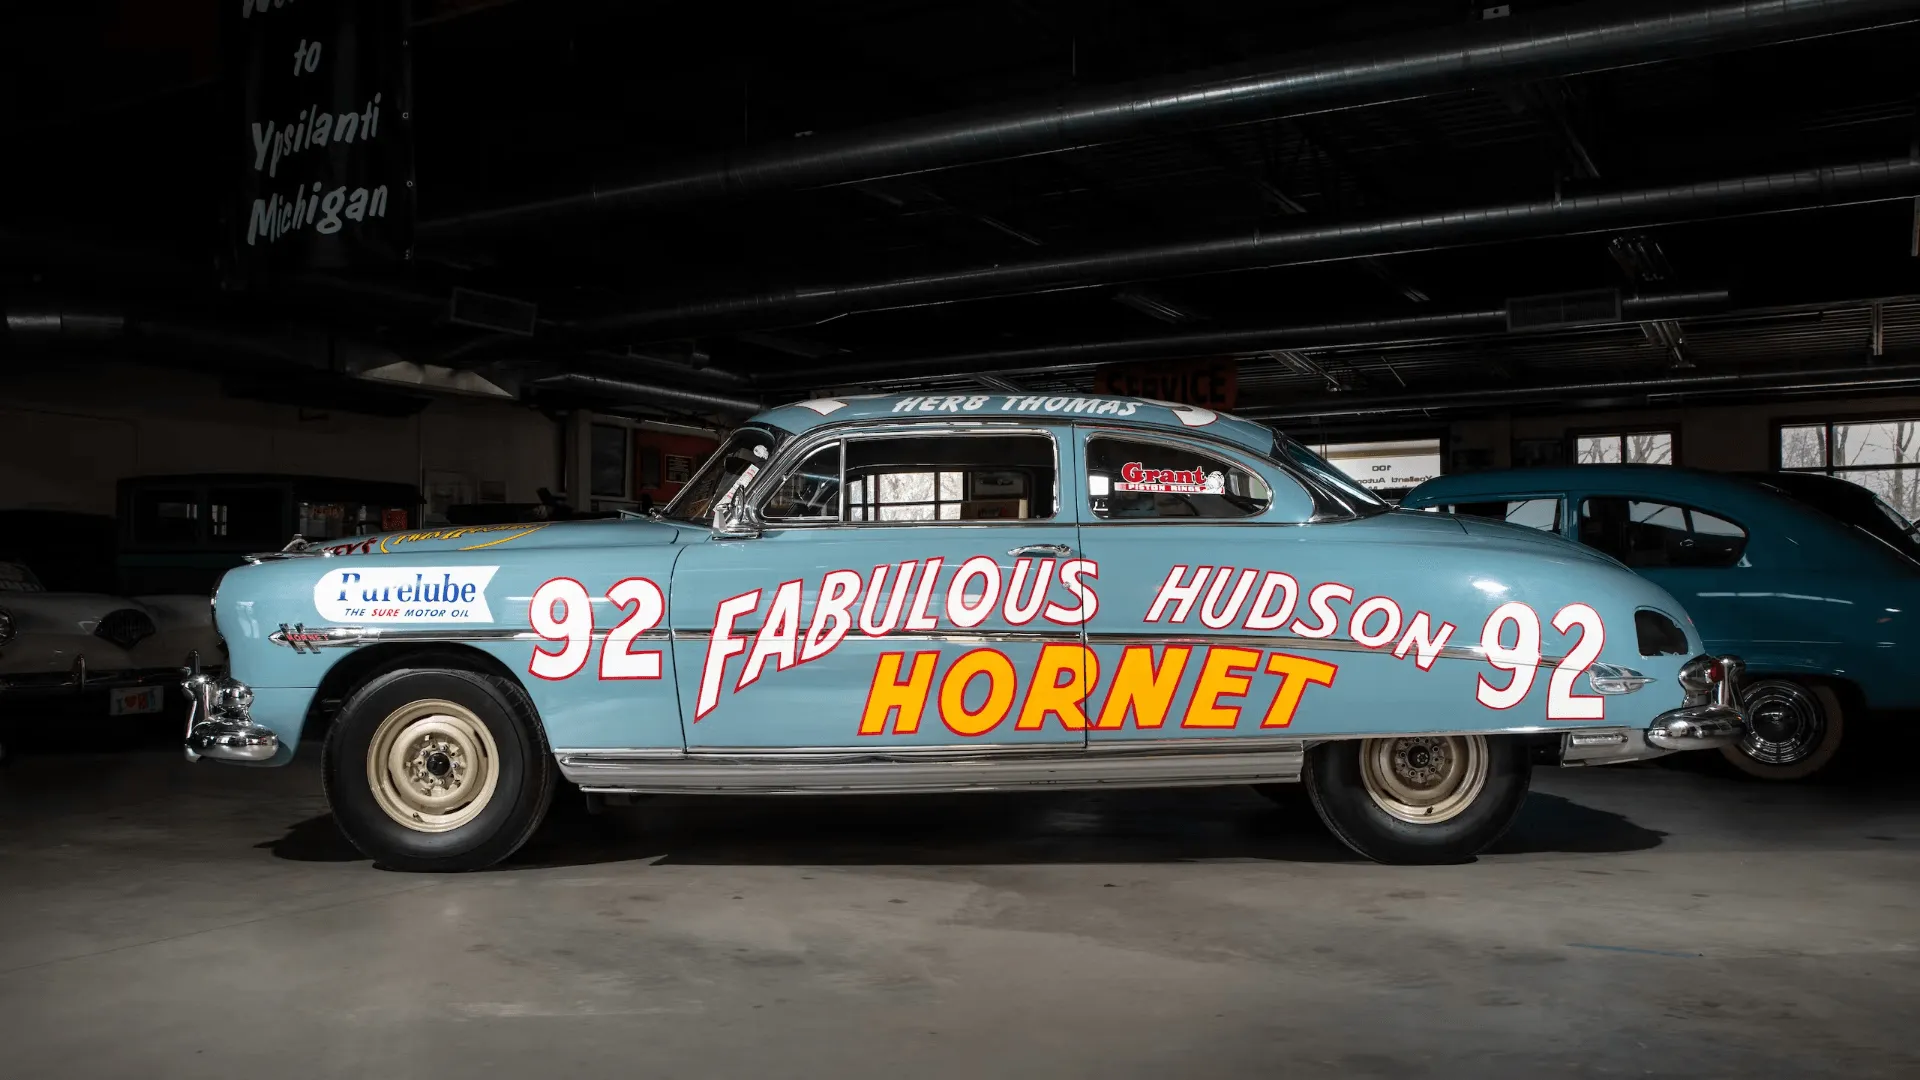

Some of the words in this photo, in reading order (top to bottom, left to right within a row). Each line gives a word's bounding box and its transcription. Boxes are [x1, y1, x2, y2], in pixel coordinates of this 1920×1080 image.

[294, 39, 322, 76] to
[251, 92, 382, 178] Ypsilanti
[247, 181, 388, 246] Michigan
[892, 395, 990, 413] HERB
[1001, 396, 1144, 416] THOMAS
[1121, 461, 1207, 485] Grant
[1170, 485, 1202, 493] RINGS
[337, 573, 477, 603] Purelube
[344, 608, 366, 617] THE
[371, 608, 401, 617] SURE
[404, 609, 446, 617] MOTOR
[451, 609, 470, 617] OIL
[528, 576, 665, 681] 92
[693, 555, 1099, 724] FABULOUS
[1143, 564, 1458, 672] HUDSON
[1475, 601, 1606, 720] 92
[856, 642, 1339, 738] HORNET
